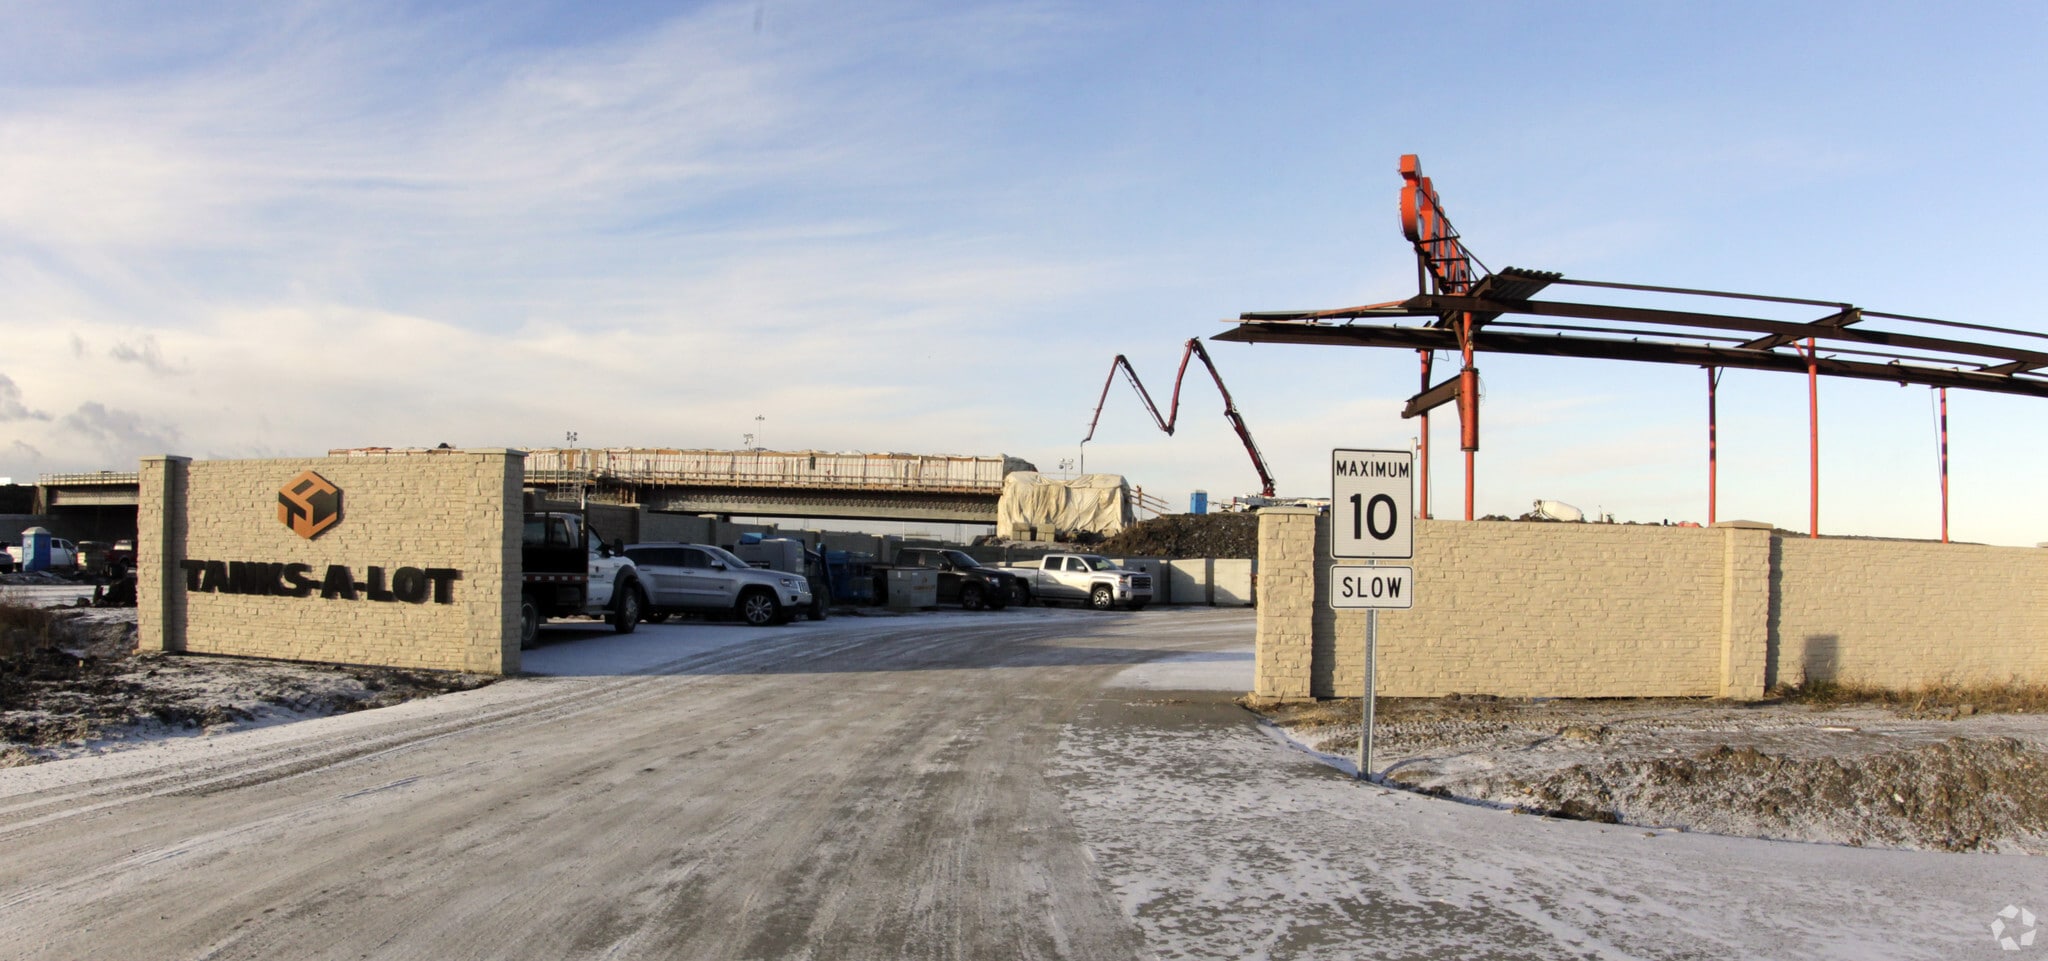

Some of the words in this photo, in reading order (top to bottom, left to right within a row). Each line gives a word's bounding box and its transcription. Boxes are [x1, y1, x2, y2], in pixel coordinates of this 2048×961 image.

[1336, 460, 1409, 478] MAXIMUM
[1350, 493, 1398, 541] 10
[180, 559, 460, 604] TANKS-A-LOT
[1342, 576, 1402, 599] SLOW
